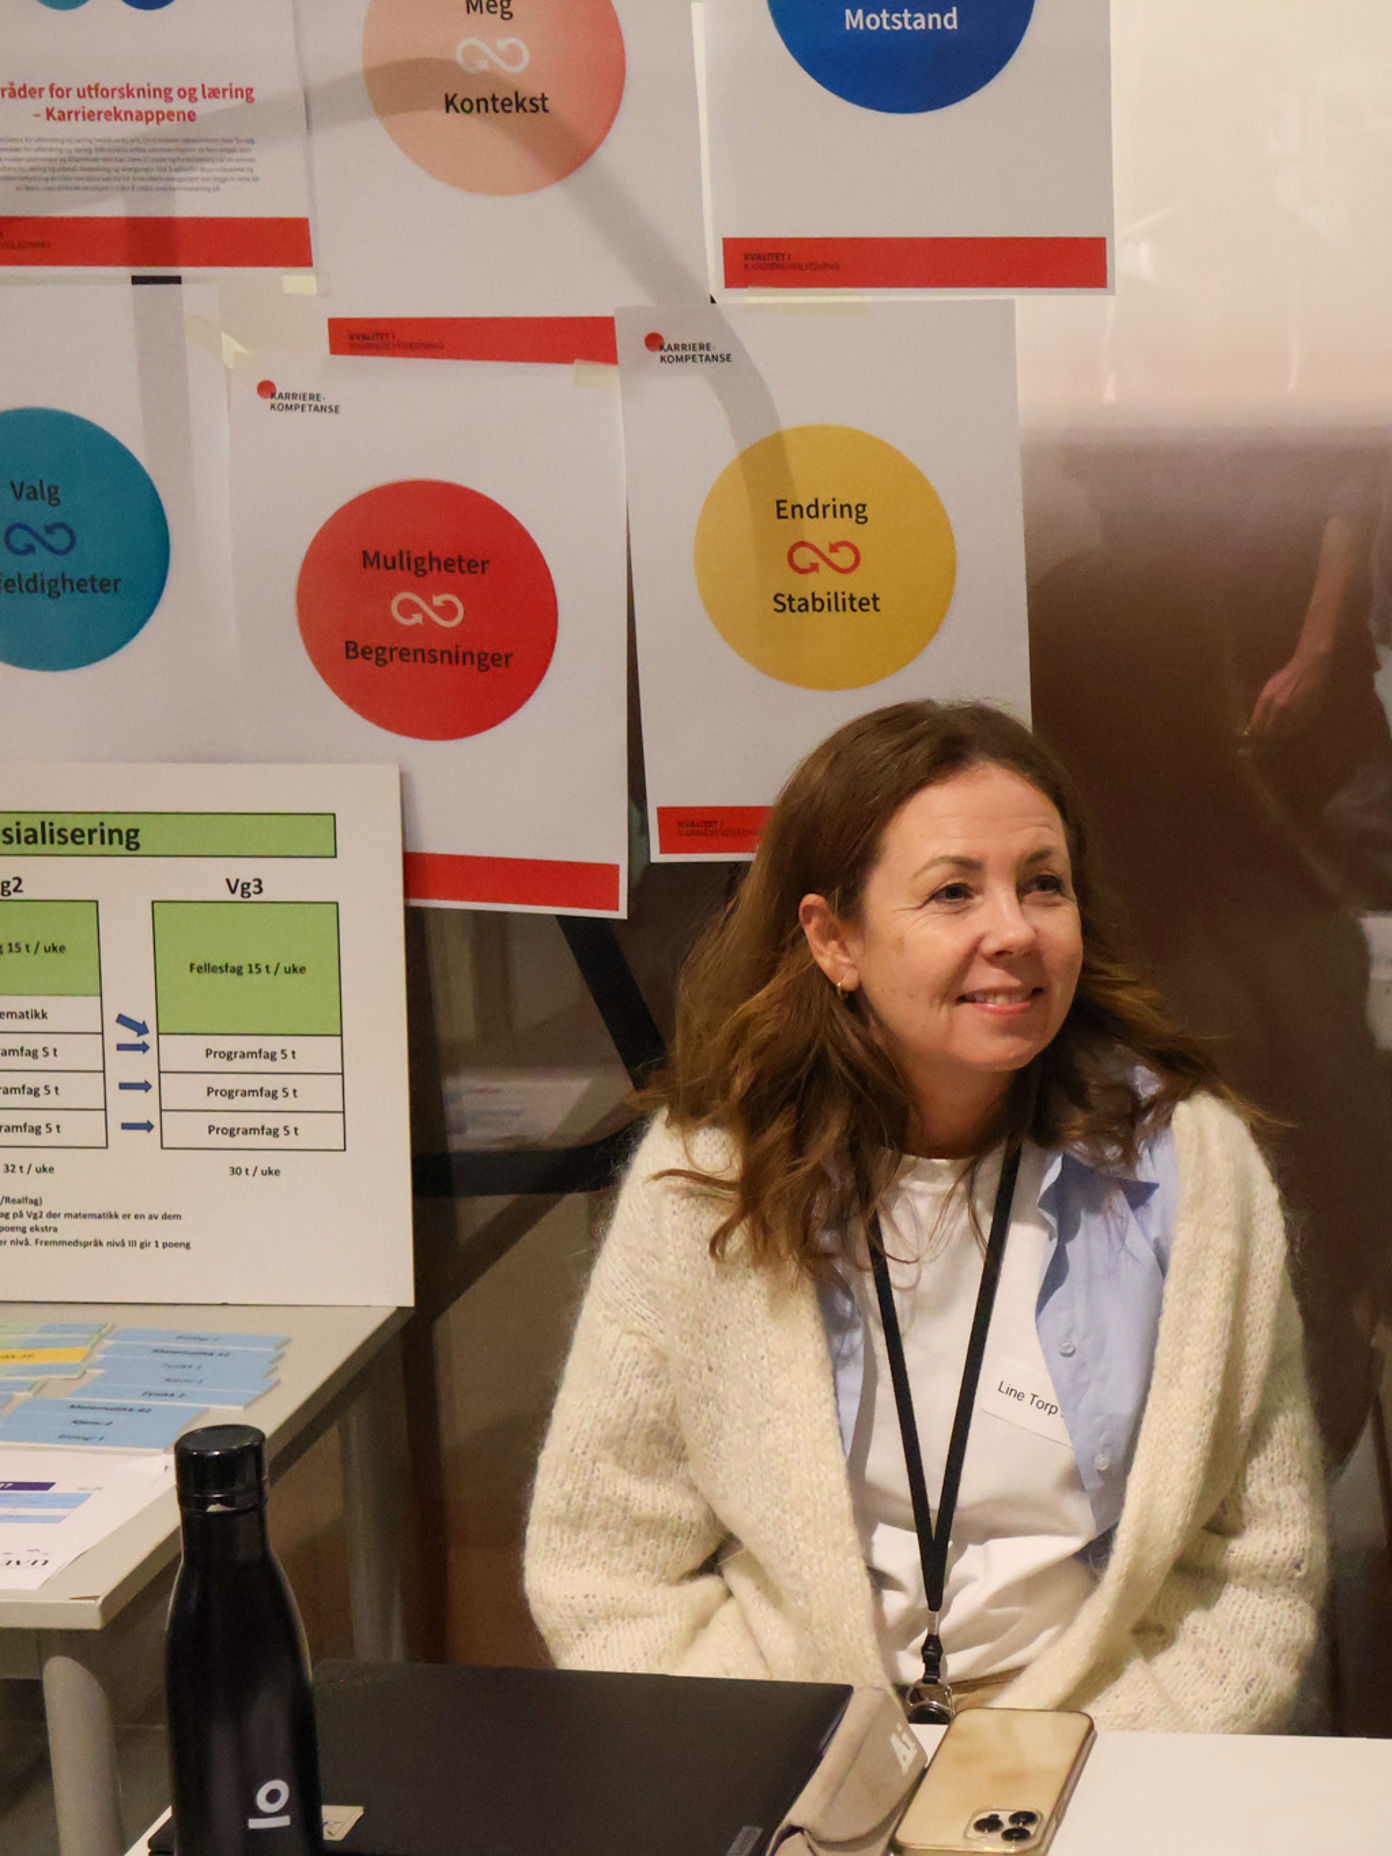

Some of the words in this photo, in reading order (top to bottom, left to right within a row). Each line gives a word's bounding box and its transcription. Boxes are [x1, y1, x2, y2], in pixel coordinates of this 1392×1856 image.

[465, 0, 514, 20] Meg
[844, 7, 958, 31] Motstand
[48, 82, 72, 99] for
[77, 82, 173, 103] utforskning
[178, 86, 198, 103] og
[201, 82, 255, 103] læring
[444, 91, 549, 114] Kontekst
[45, 105, 197, 125] Karriereknappene
[659, 353, 733, 364] KOMPETANSE
[270, 402, 341, 414] KOMPETANSE
[10, 479, 61, 507] Valg
[775, 497, 868, 525] Endring
[361, 550, 490, 578] Muligheter
[773, 591, 880, 613] Stabilitet
[344, 640, 514, 673] Begrensninger
[1, 820, 141, 851] sialisering
[0, 876, 23, 897] g2
[225, 877, 264, 898] Vg3
[7, 943, 21, 953] 15
[25, 944, 30, 953] t
[34, 942, 40, 955] /
[43, 942, 66, 953] uke
[189, 962, 244, 976] Fellesfag
[247, 963, 261, 974] 15
[266, 964, 271, 975] t
[274, 962, 280, 976] /
[284, 963, 307, 975] uke
[42, 1046, 49, 1057] 5
[53, 1047, 58, 1057] t
[205, 1047, 277, 1062] Programfag
[280, 1049, 288, 1060] 5
[291, 1050, 296, 1060] t
[44, 1085, 51, 1095] 5
[54, 1085, 60, 1095] t
[206, 1085, 278, 1100] Programfag
[282, 1087, 289, 1098] 5
[292, 1088, 298, 1098] t
[45, 1123, 52, 1133] 5
[56, 1123, 61, 1133] t
[207, 1124, 280, 1138] Programfag
[283, 1126, 290, 1136] 5
[293, 1126, 299, 1136] t
[3, 1163, 16, 1174] 32
[19, 1165, 24, 1174] t
[26, 1163, 32, 1175] /
[35, 1164, 55, 1174] uke
[229, 1166, 242, 1176] 30
[245, 1167, 250, 1176] t
[252, 1166, 258, 1177] /
[261, 1166, 281, 1176] uke
[12, 1209, 24, 1220] på
[26, 1210, 43, 1220] Vg2
[46, 1211, 61, 1219] der
[64, 1211, 119, 1221] matematikk
[161, 1211, 182, 1220] dem
[29, 1224, 58, 1233] ekstra
[10, 1237, 32, 1246] nivå.
[34, 1238, 103, 1249] Fremmedspråk
[106, 1238, 126, 1247] nivå
[139, 1239, 151, 1249] gir
[154, 1240, 159, 1248] 1
[162, 1241, 191, 1250] poeng
[997, 1380, 1025, 1401] Line
[1029, 1393, 1059, 1416] Torp
